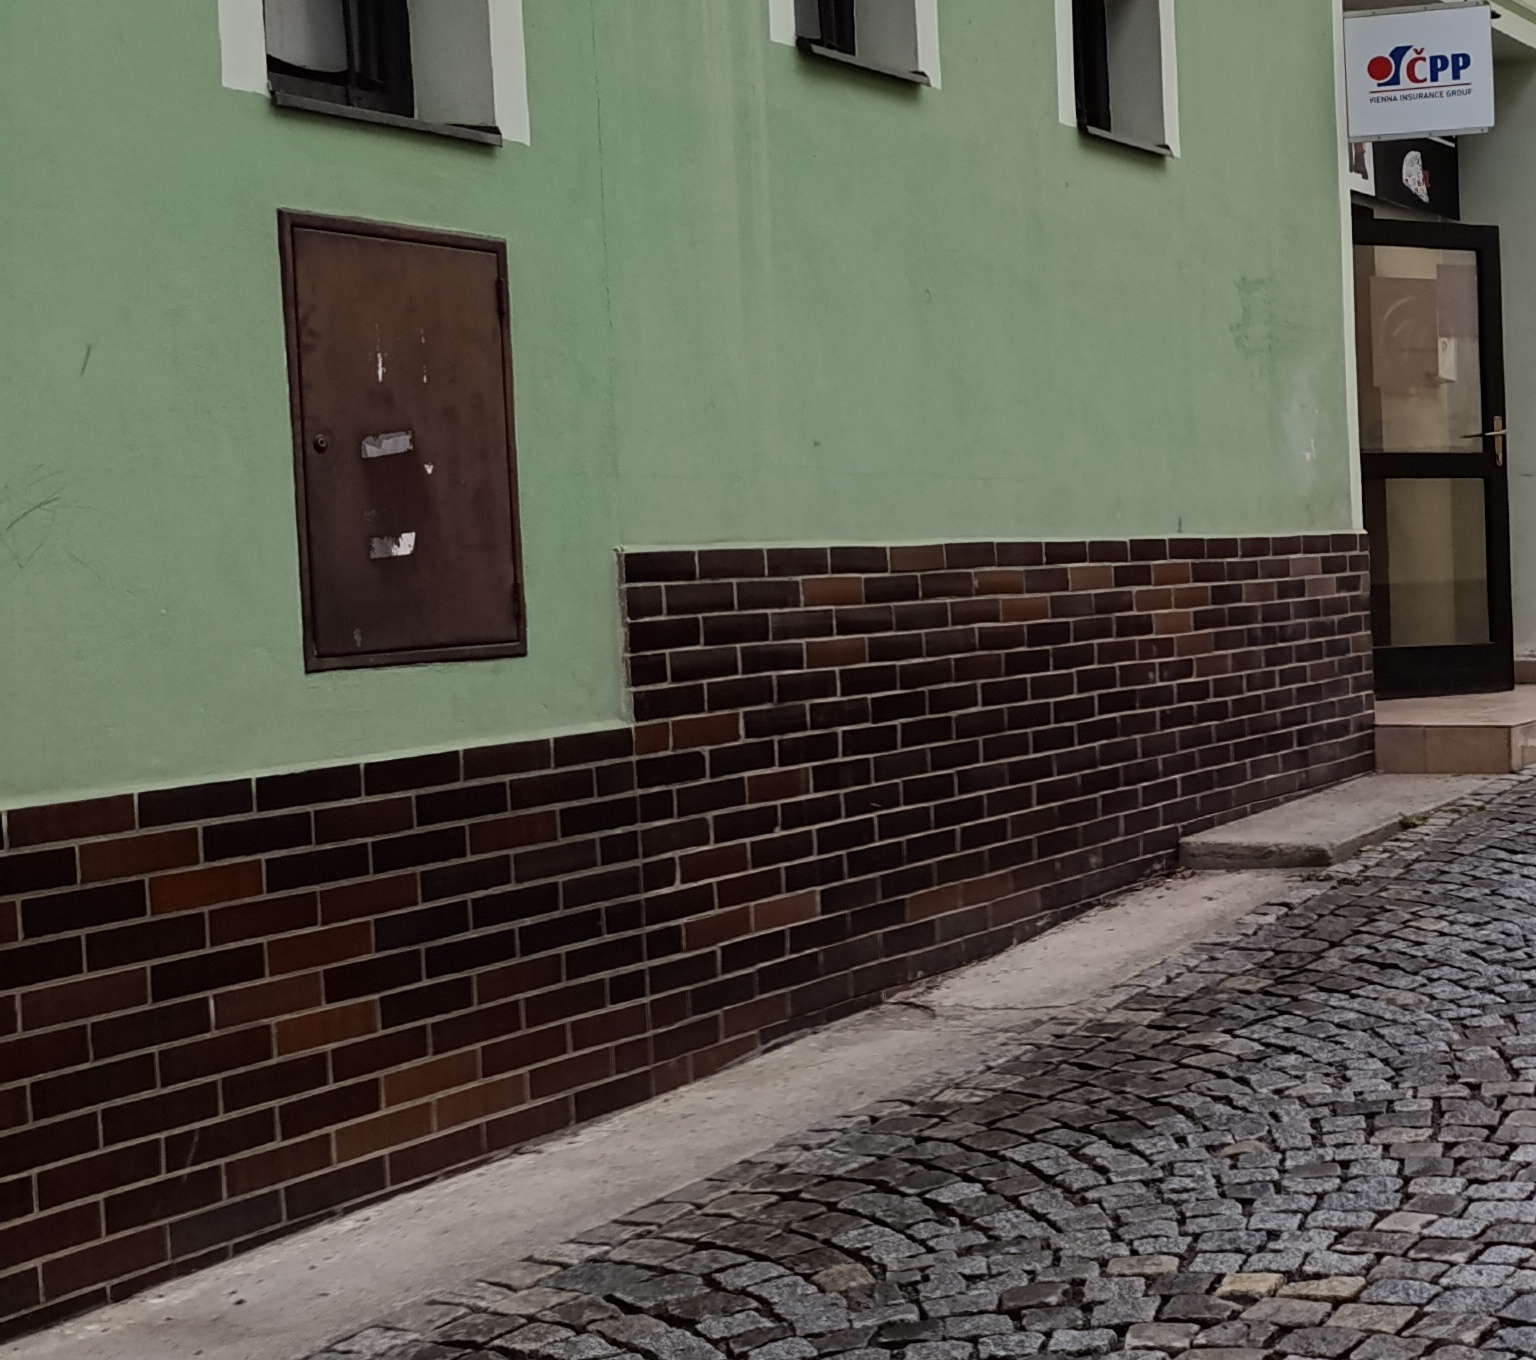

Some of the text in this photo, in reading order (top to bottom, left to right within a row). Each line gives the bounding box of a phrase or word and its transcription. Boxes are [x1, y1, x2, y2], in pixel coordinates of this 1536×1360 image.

[1406, 47, 1471, 84] ČPP
[1369, 88, 1472, 103] VIENNA INSURANCE GROUP
